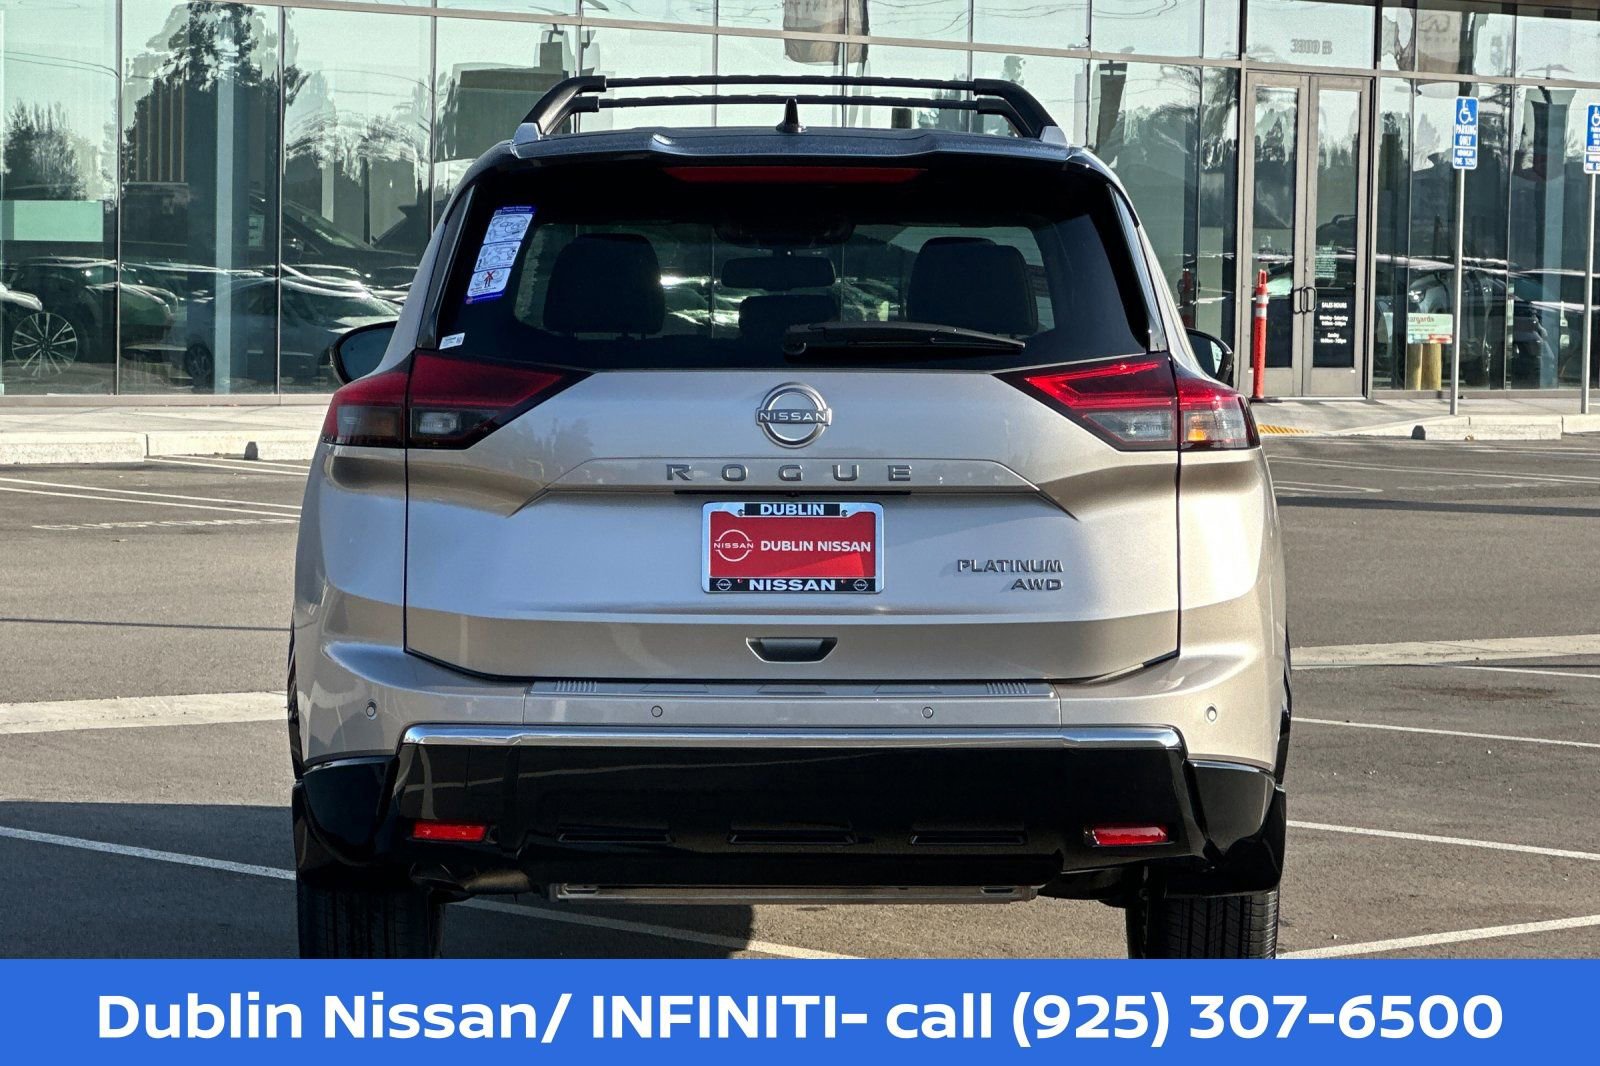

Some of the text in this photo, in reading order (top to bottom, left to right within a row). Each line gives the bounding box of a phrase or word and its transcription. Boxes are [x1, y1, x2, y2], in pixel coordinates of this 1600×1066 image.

[1455, 124, 1477, 135] PARKING
[1459, 135, 1472, 146] ONLY
[759, 412, 826, 421] NISSAN
[666, 463, 912, 482] ROGUE
[760, 503, 825, 516] DUBLIN
[713, 541, 754, 549] NISSAN
[760, 540, 871, 552] DUBLIN NISSAN
[957, 559, 1064, 573] PLATINUM
[749, 579, 836, 591] NISSAN
[1010, 578, 1064, 591] AWD
